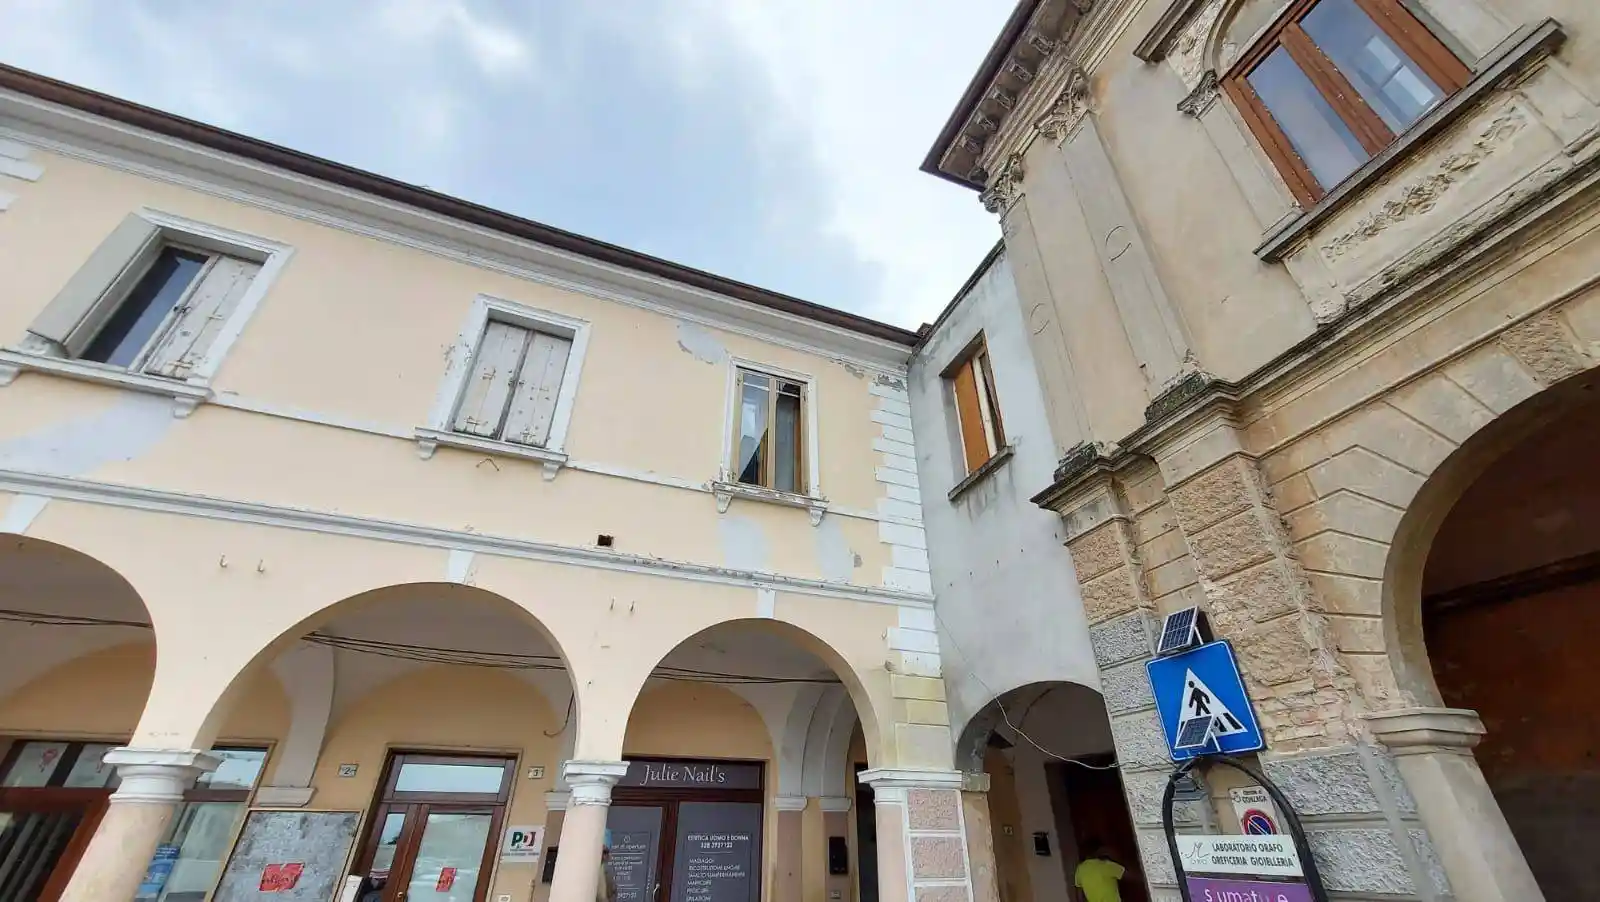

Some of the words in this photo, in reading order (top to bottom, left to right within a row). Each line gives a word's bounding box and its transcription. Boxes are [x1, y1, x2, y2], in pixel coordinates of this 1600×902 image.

[640, 763, 679, 786] Julie
[682, 764, 726, 783] Nail's
[1242, 795, 1267, 804] GONZAGA
[1211, 842, 1257, 853] LABORATORIO
[1258, 843, 1284, 853] ORAFO
[1211, 855, 1248, 866] OREFICERIA
[1250, 855, 1295, 868] GIOIELLERIA
